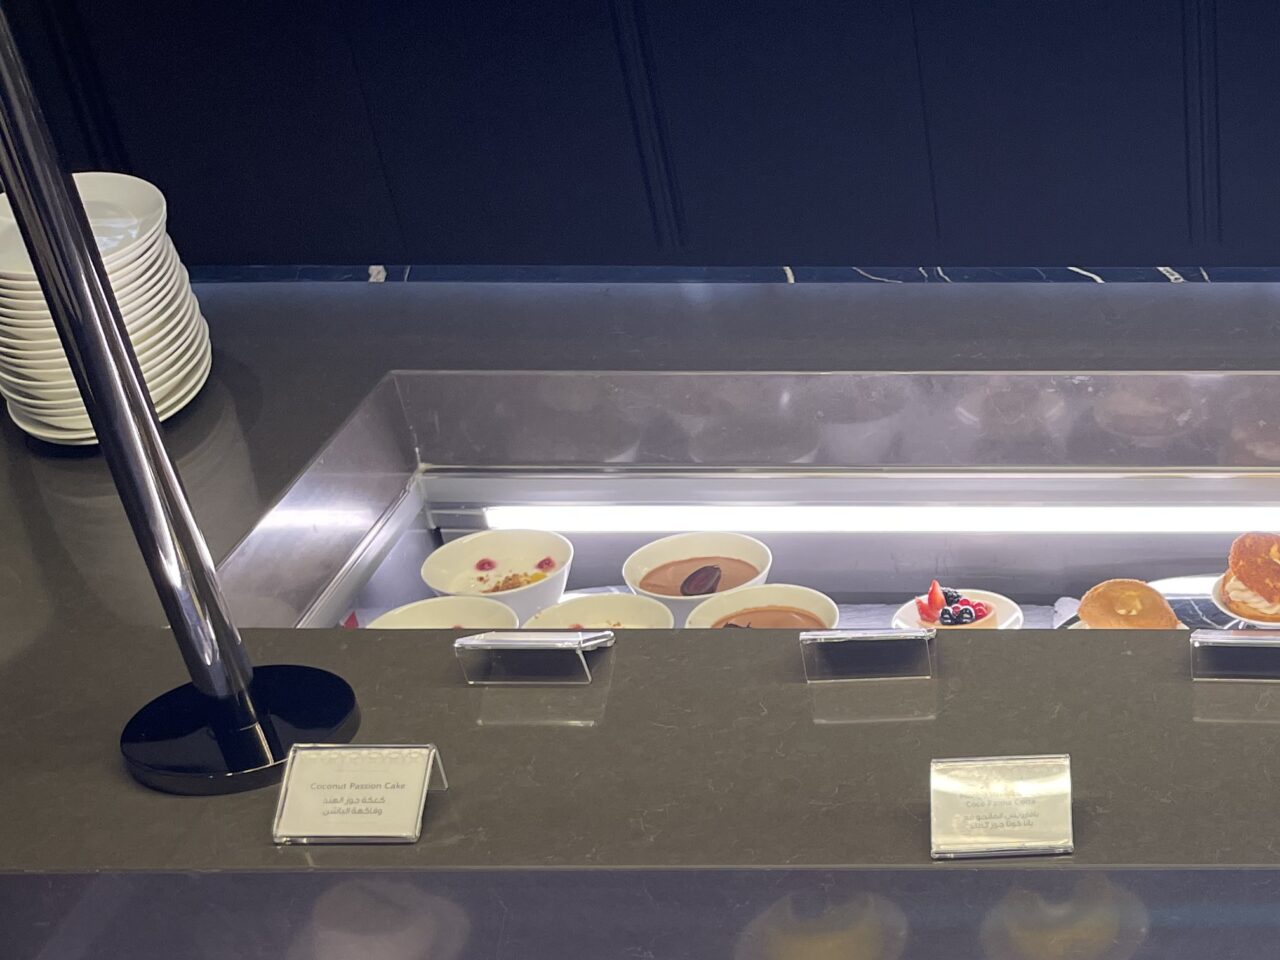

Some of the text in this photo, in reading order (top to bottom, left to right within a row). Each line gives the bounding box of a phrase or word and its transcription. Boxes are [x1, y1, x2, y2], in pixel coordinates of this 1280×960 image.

[310, 781, 406, 790] Coconut Passion Cake
